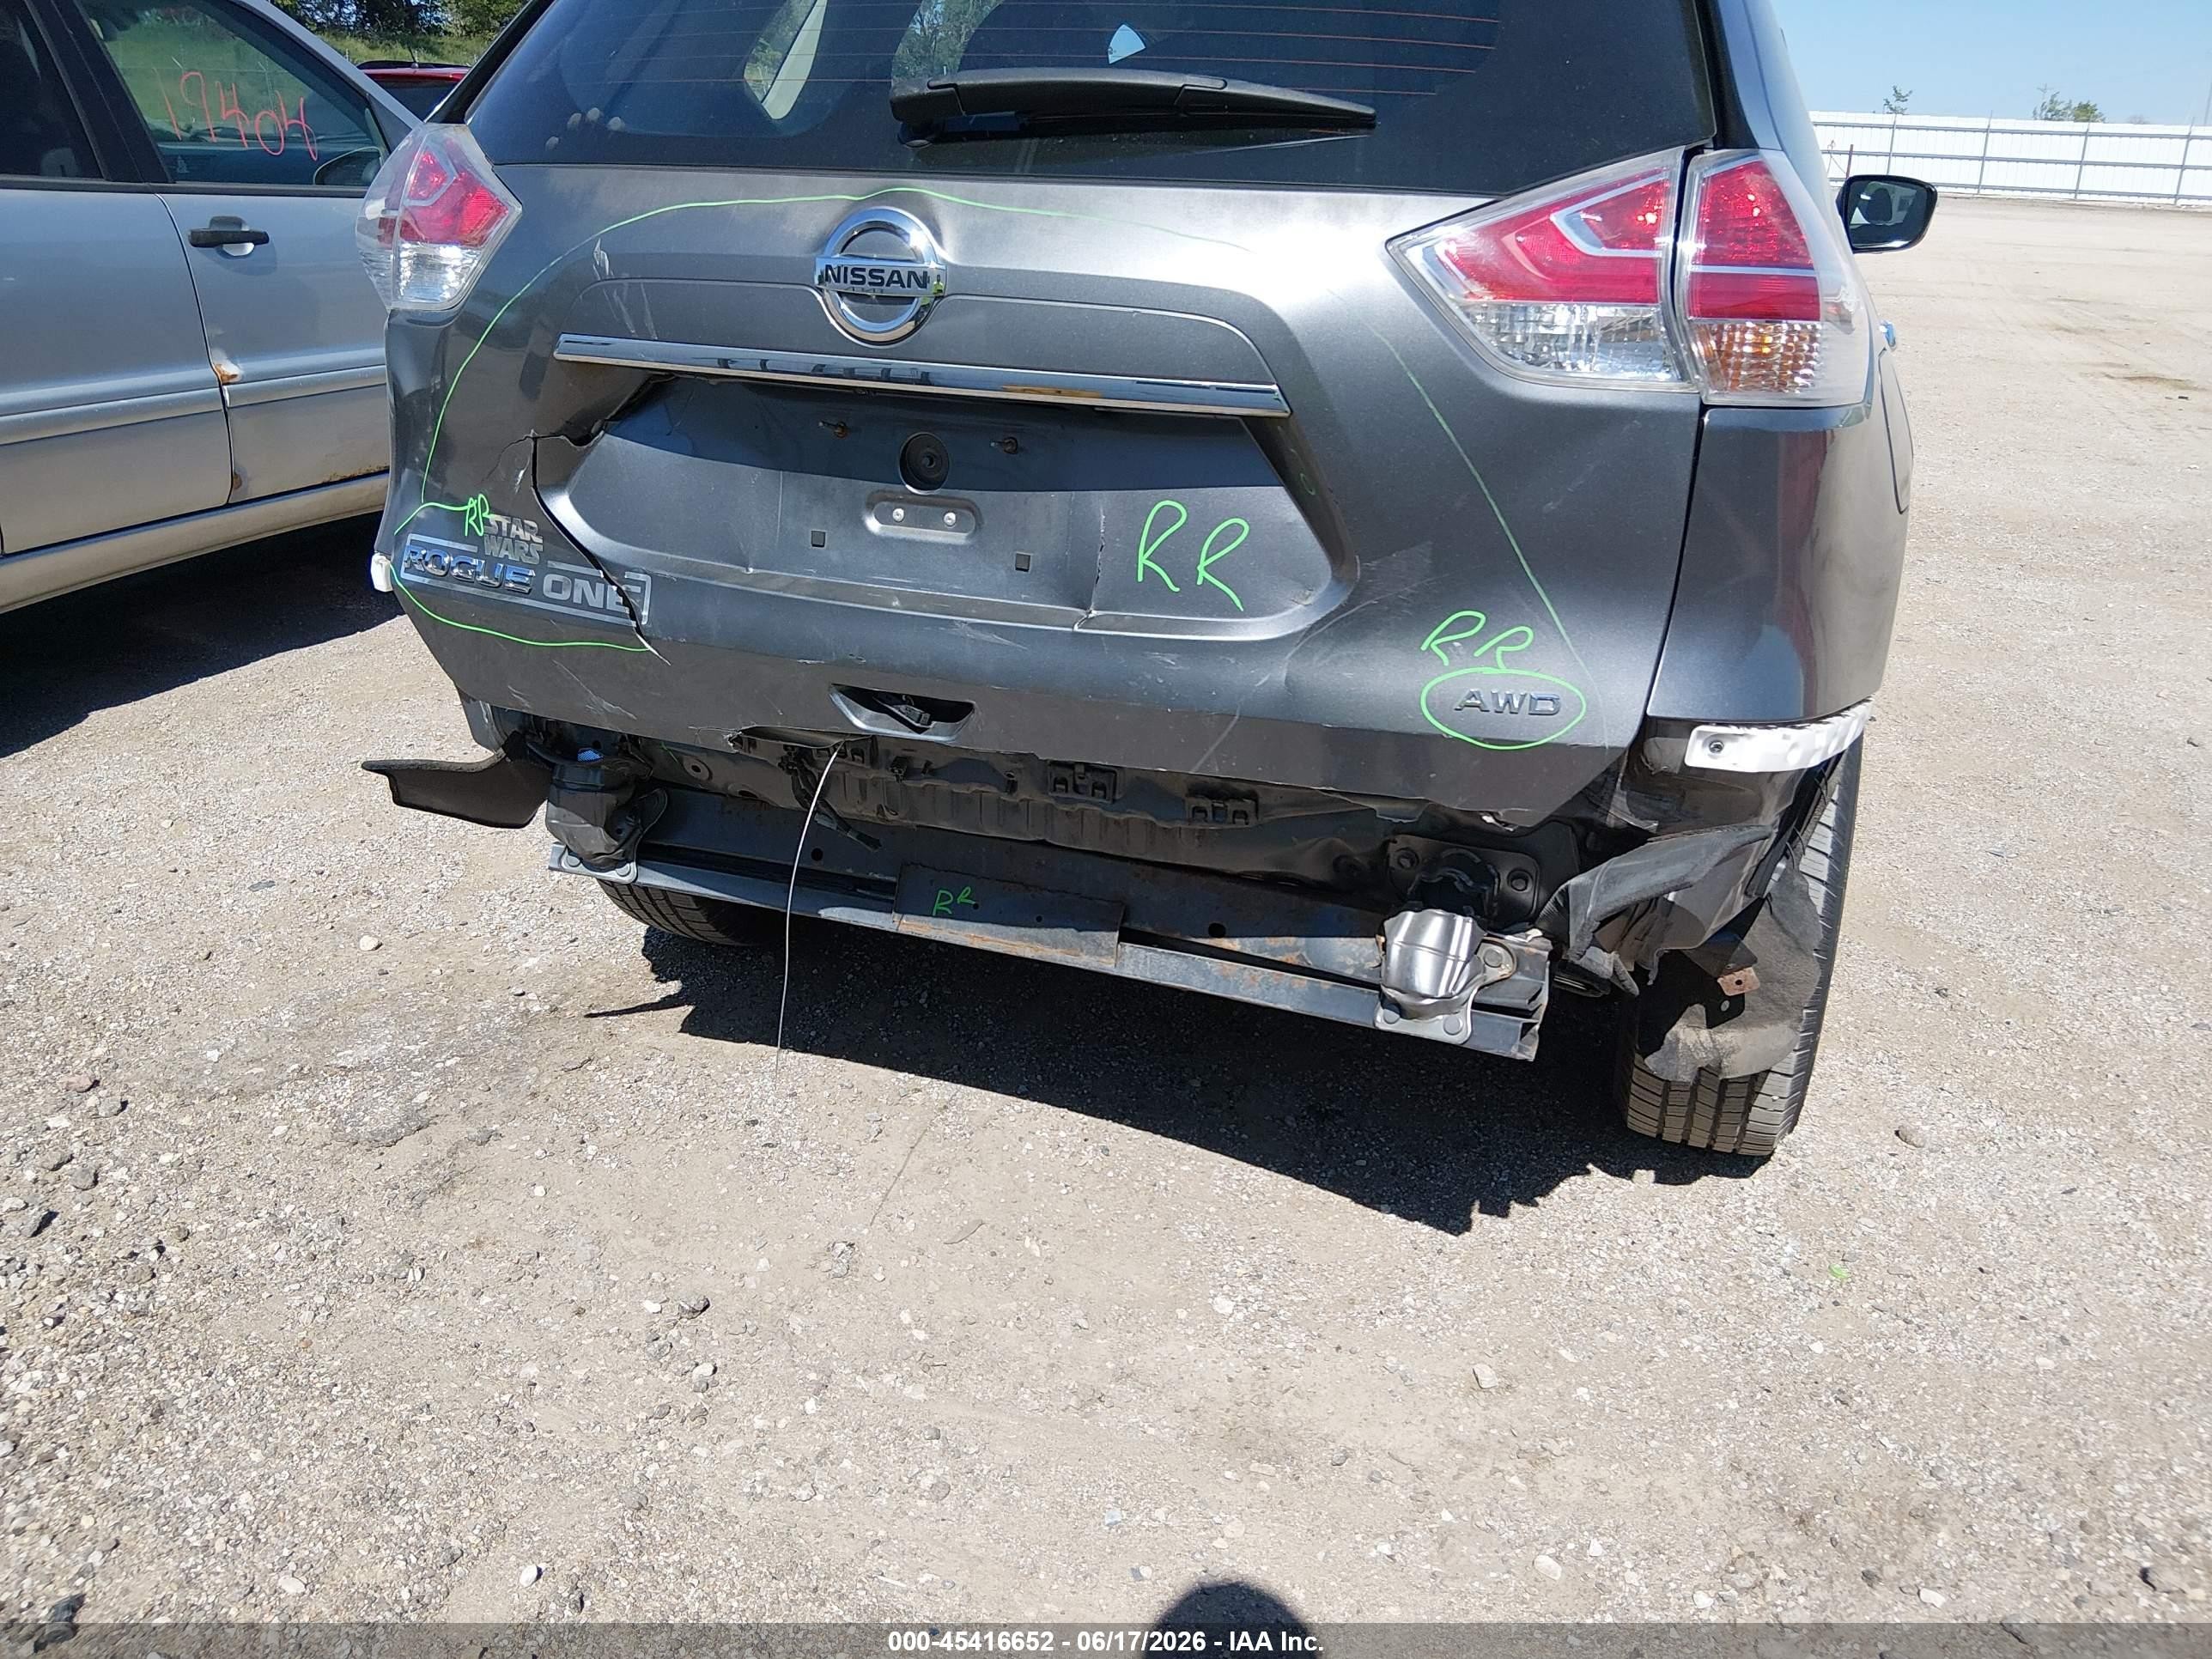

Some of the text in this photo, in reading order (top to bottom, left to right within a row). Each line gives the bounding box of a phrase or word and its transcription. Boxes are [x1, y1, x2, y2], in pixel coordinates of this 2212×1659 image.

[824, 264, 928, 289] NISSAN
[483, 515, 544, 543] STAR
[483, 534, 544, 565] WARS
[404, 544, 641, 613] ROGUE ONE
[1454, 688, 1561, 716] AWD
